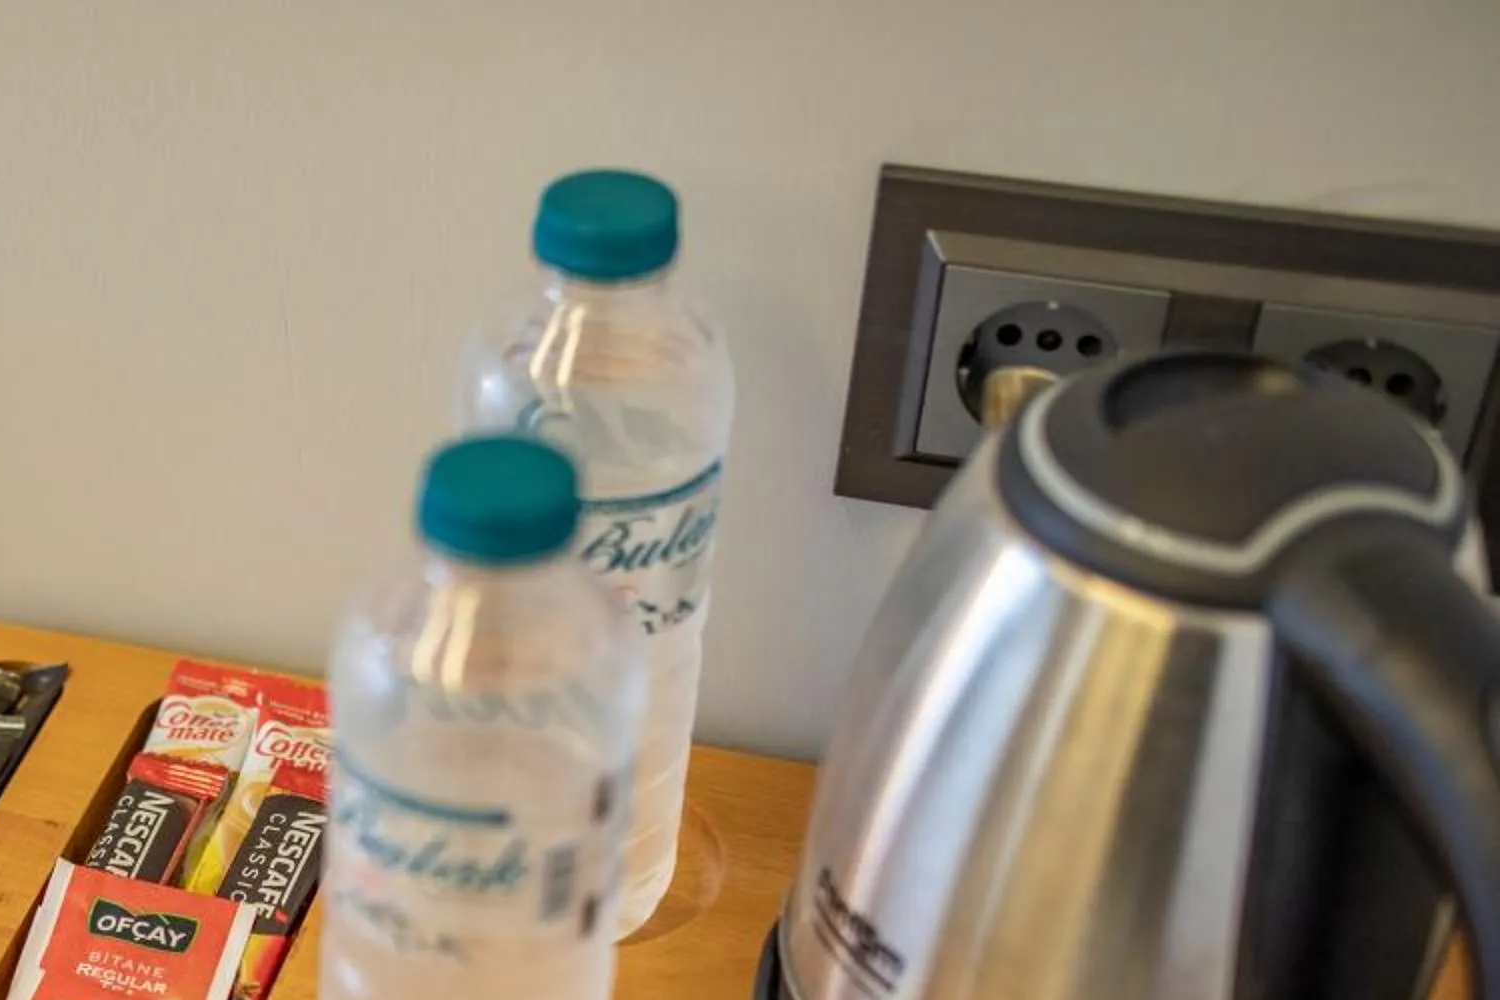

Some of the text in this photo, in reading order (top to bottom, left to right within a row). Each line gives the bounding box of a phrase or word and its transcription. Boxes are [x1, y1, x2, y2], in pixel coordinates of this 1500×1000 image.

[104, 790, 176, 878] NESCA
[230, 812, 287, 904] CLASSIC
[97, 914, 187, 948] OFÇAY
[76, 962, 168, 995] REGULAR
[88, 951, 166, 979] BITANE
